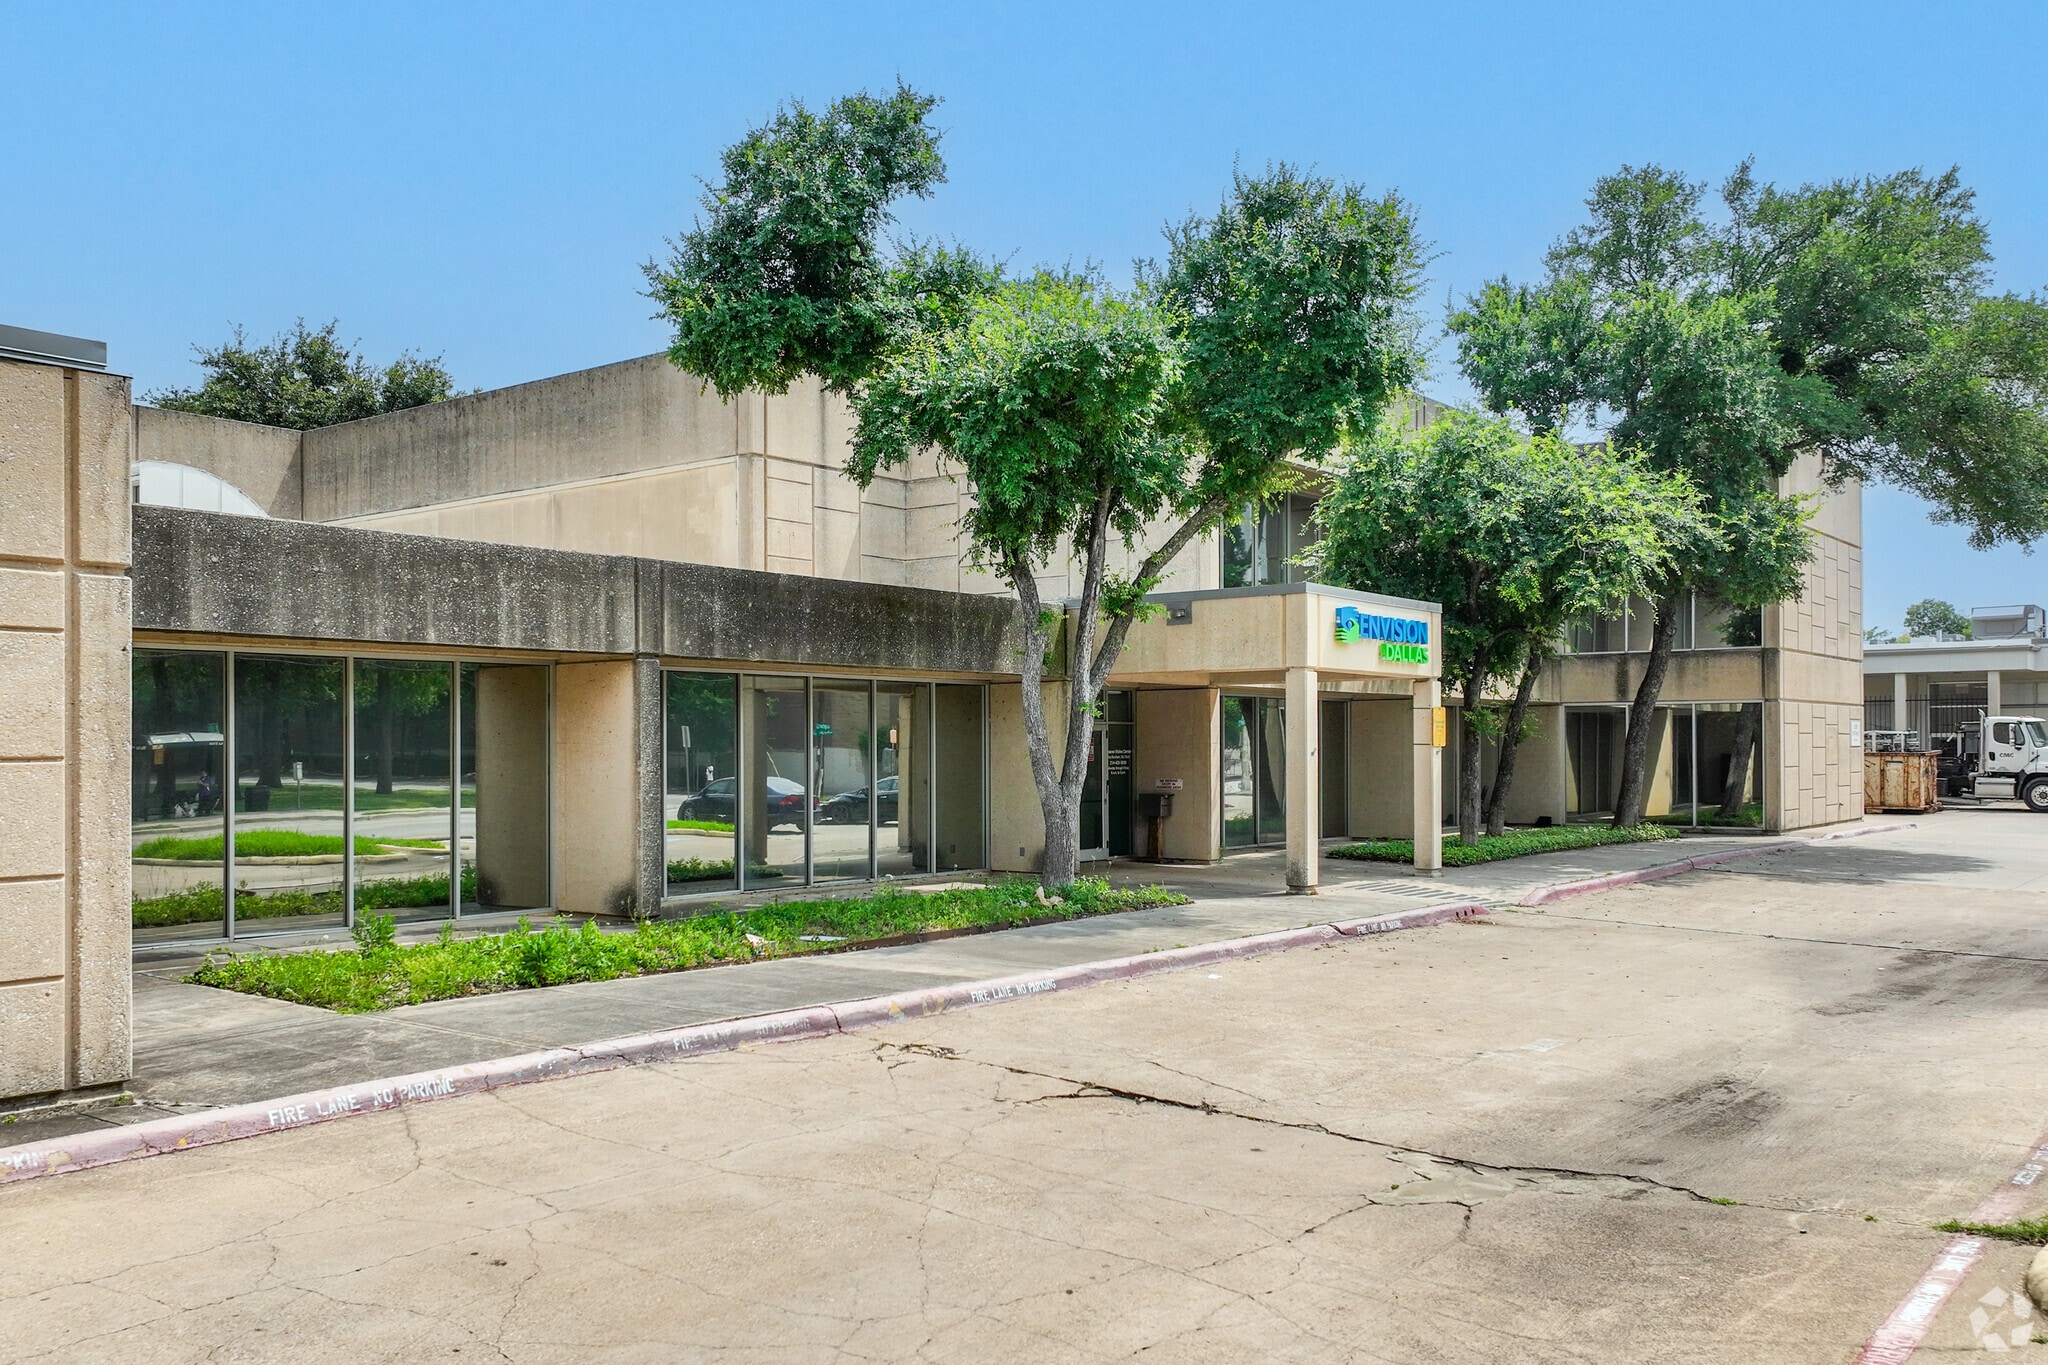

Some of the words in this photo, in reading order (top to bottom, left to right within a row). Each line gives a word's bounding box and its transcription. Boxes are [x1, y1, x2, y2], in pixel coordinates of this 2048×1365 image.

[1359, 613, 1428, 644] ENVISION
[1381, 643, 1429, 664] DALLAS
[970, 989, 990, 1003] FIRE
[991, 986, 1013, 999] LANE
[1016, 984, 1027, 996] NO
[1028, 978, 1057, 993] PARKING
[267, 1103, 308, 1127] FIRE
[315, 1093, 361, 1116] LANE
[373, 1088, 394, 1107] NO
[399, 1077, 456, 1101] PARKING
